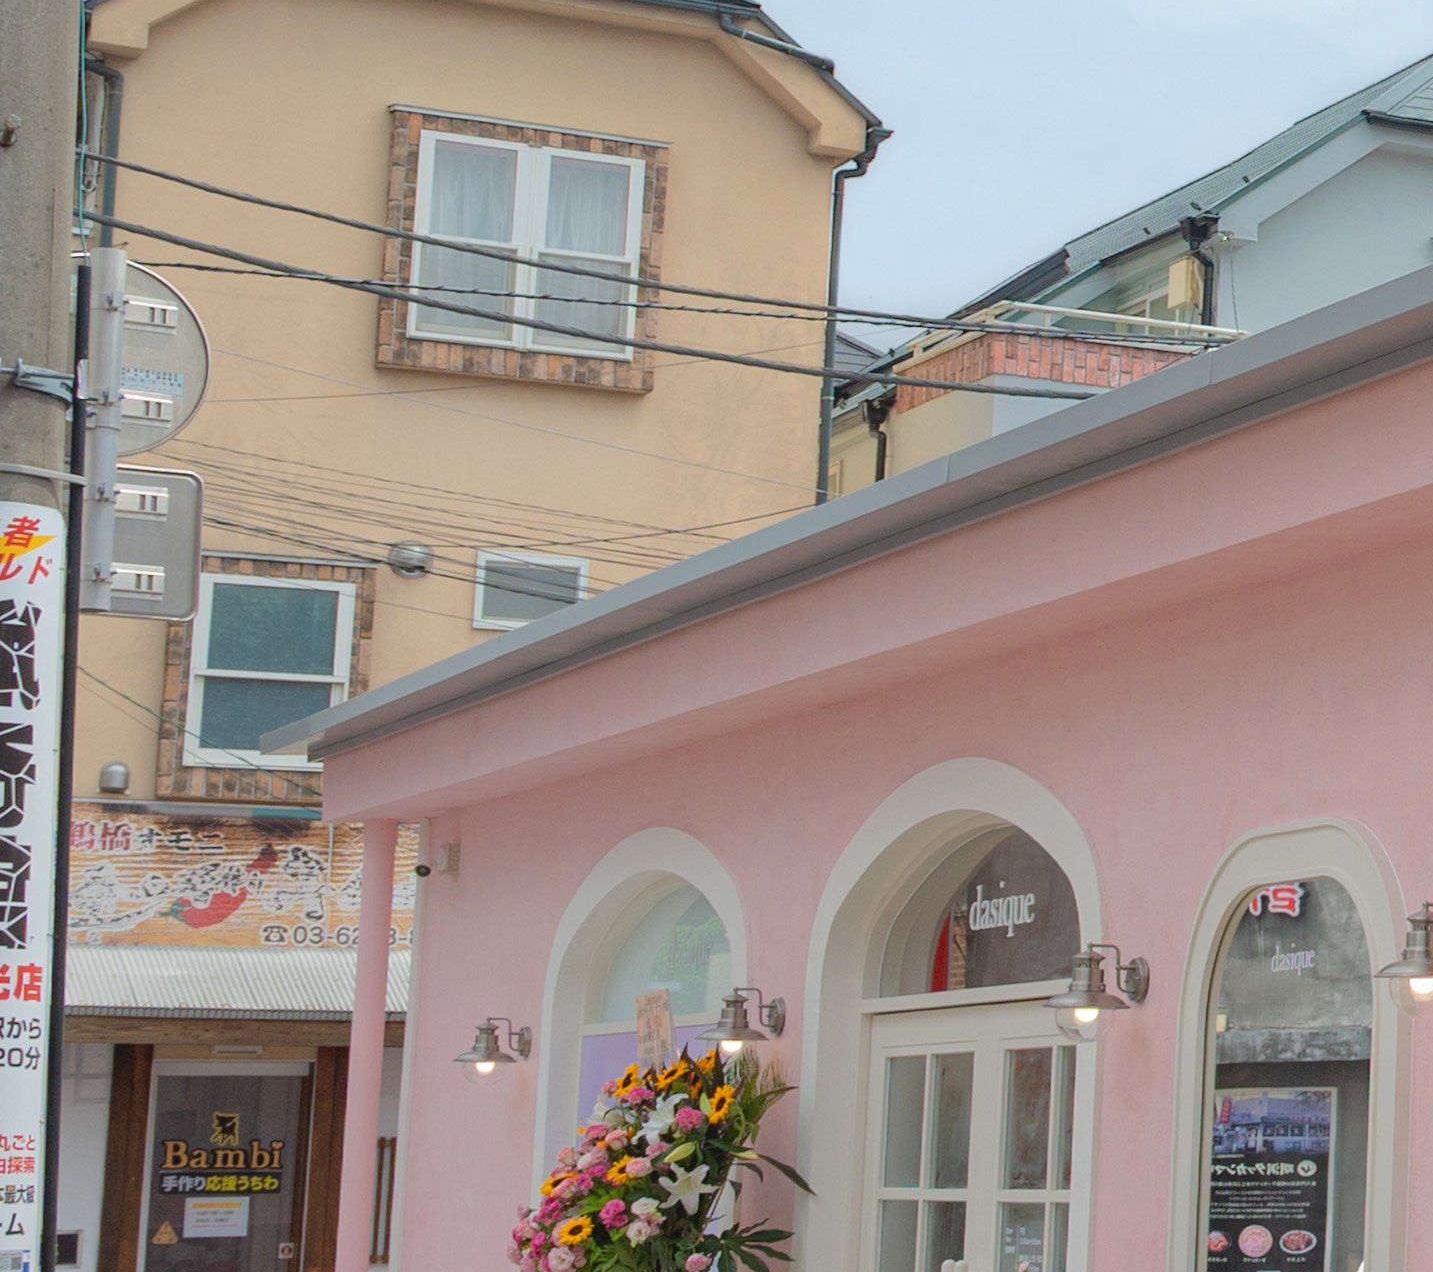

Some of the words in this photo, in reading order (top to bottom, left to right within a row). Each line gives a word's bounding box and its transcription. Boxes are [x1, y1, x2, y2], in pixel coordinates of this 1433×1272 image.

[969, 880, 1036, 938] dasique
[1271, 942, 1317, 976] dasique
[161, 1140, 285, 1169] Bambi
[162, 1175, 280, 1192] 手作り応援うちわ
